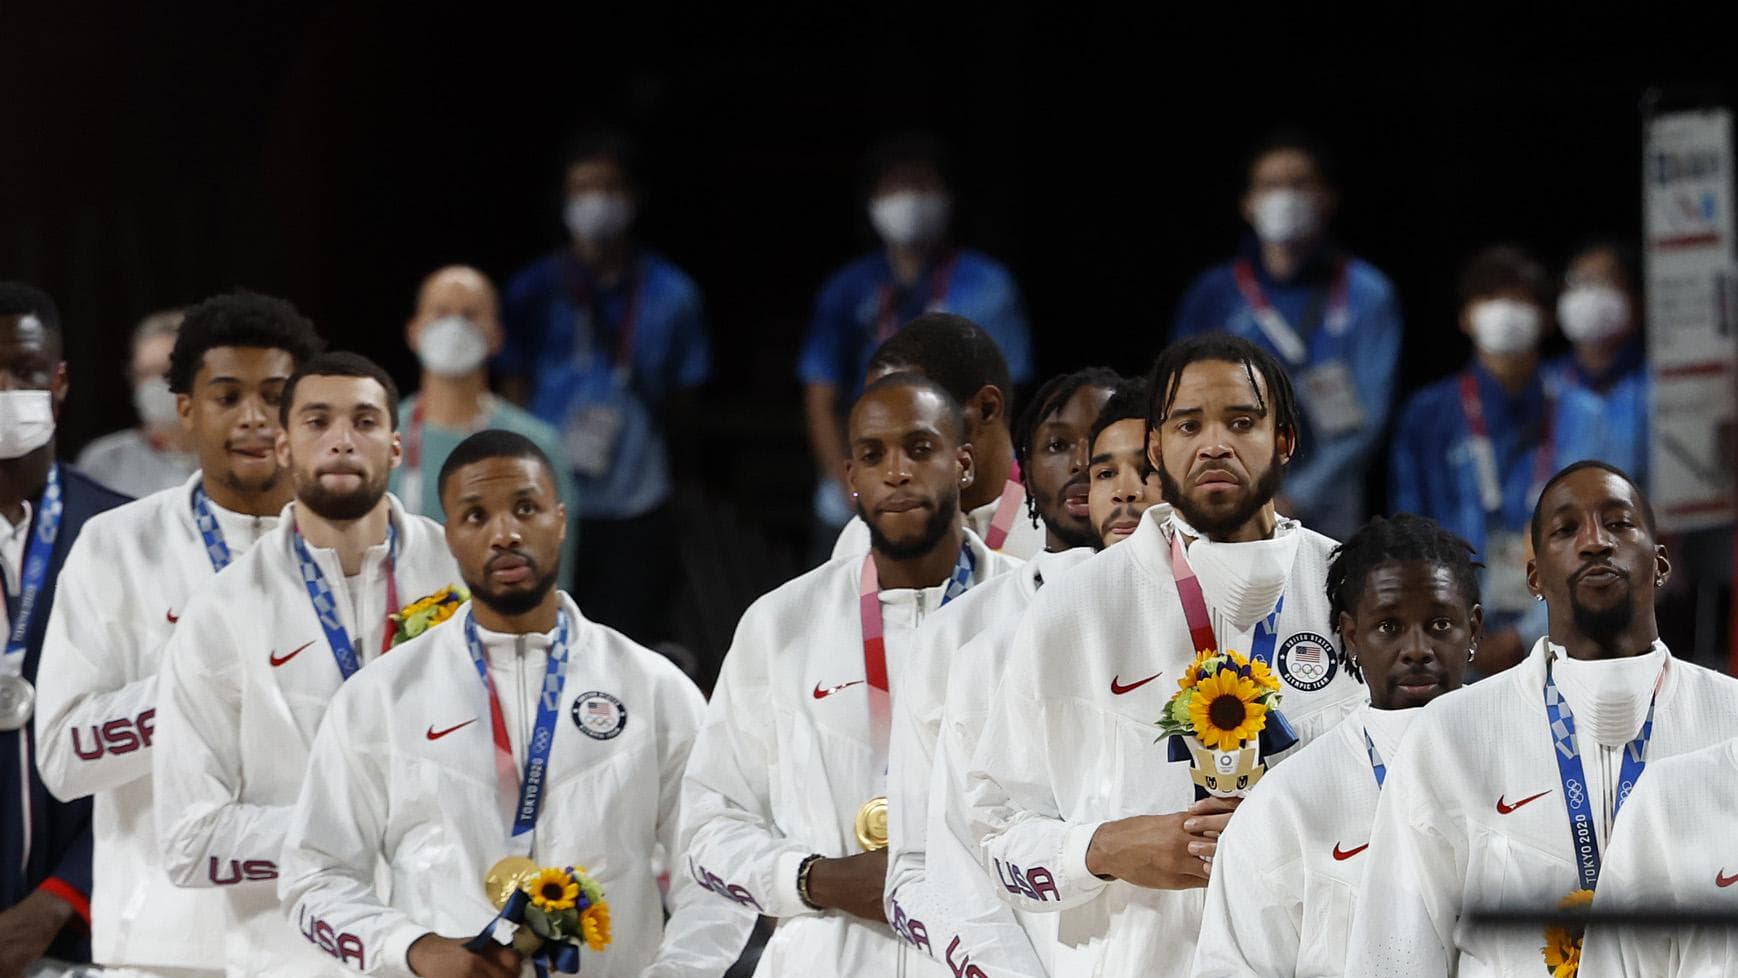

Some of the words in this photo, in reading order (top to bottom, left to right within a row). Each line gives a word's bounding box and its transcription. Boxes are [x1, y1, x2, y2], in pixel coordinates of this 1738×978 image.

[528, 757, 544, 783] 2020
[520, 785, 539, 821] TOKYO
[1575, 814, 1592, 844] 2020
[209, 856, 279, 885] US
[994, 858, 1060, 901] USA
[1581, 845, 1597, 884] TOKYO
[299, 903, 364, 970] USA
